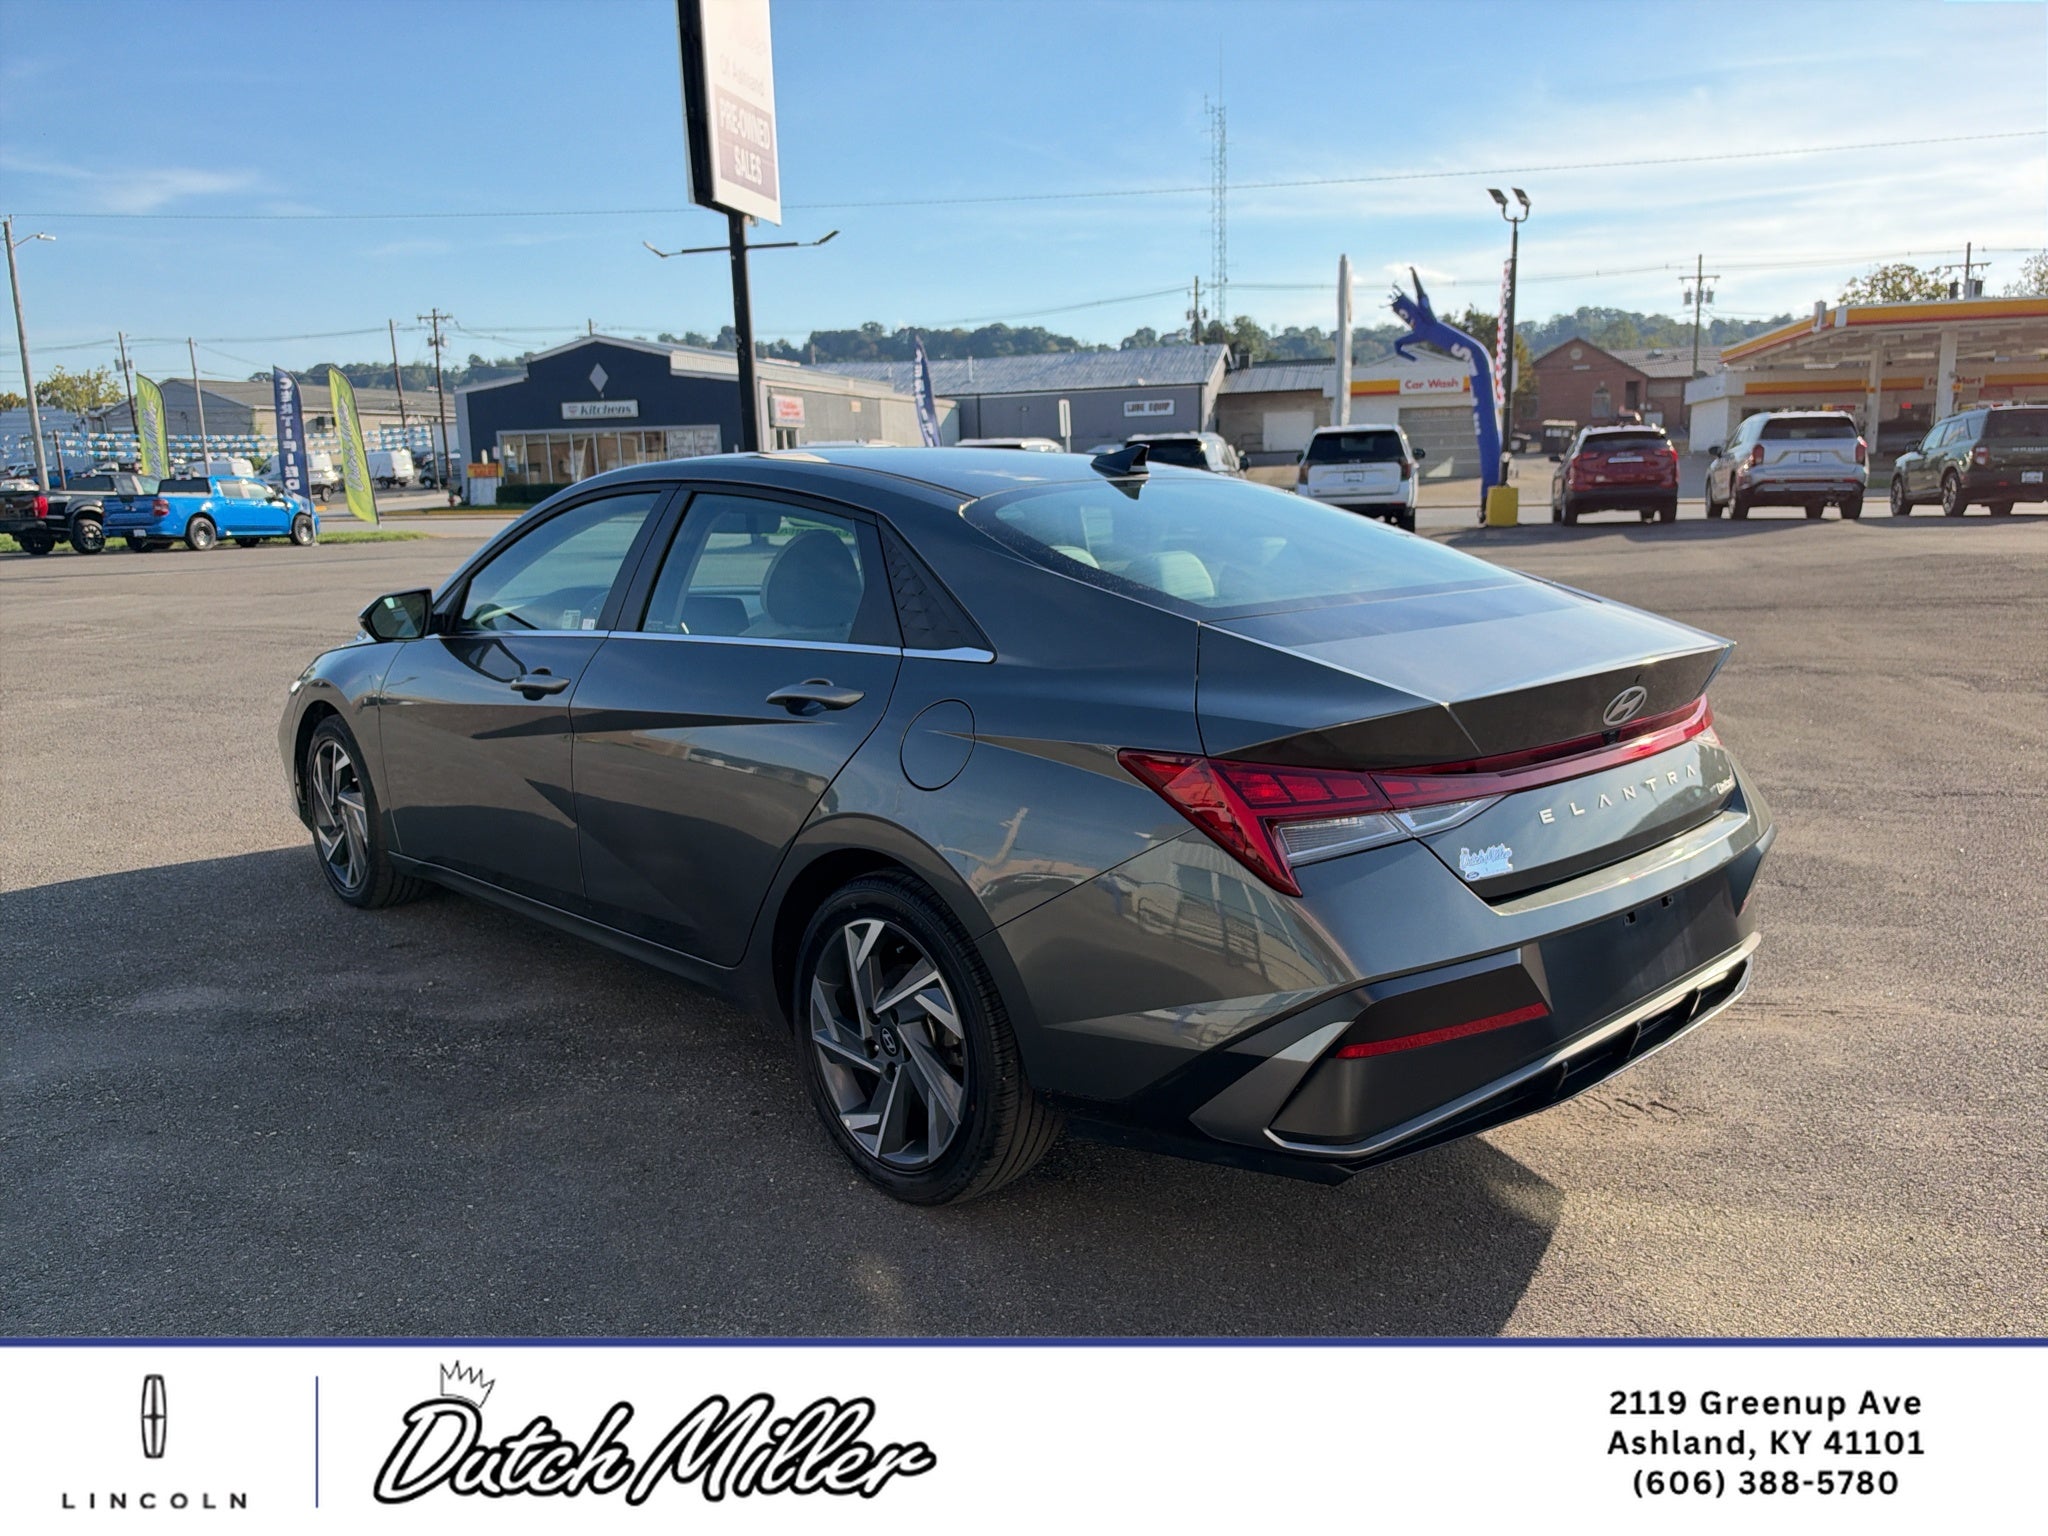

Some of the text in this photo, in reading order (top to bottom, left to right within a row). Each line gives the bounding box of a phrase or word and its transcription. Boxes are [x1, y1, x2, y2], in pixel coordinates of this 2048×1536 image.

[719, 97, 771, 151] PRE-OWNED
[733, 145, 763, 186] SALES
[1404, 377, 1459, 390] Car Wash
[580, 403, 632, 417] Kitchens
[1538, 764, 1700, 825] ELANTRA
